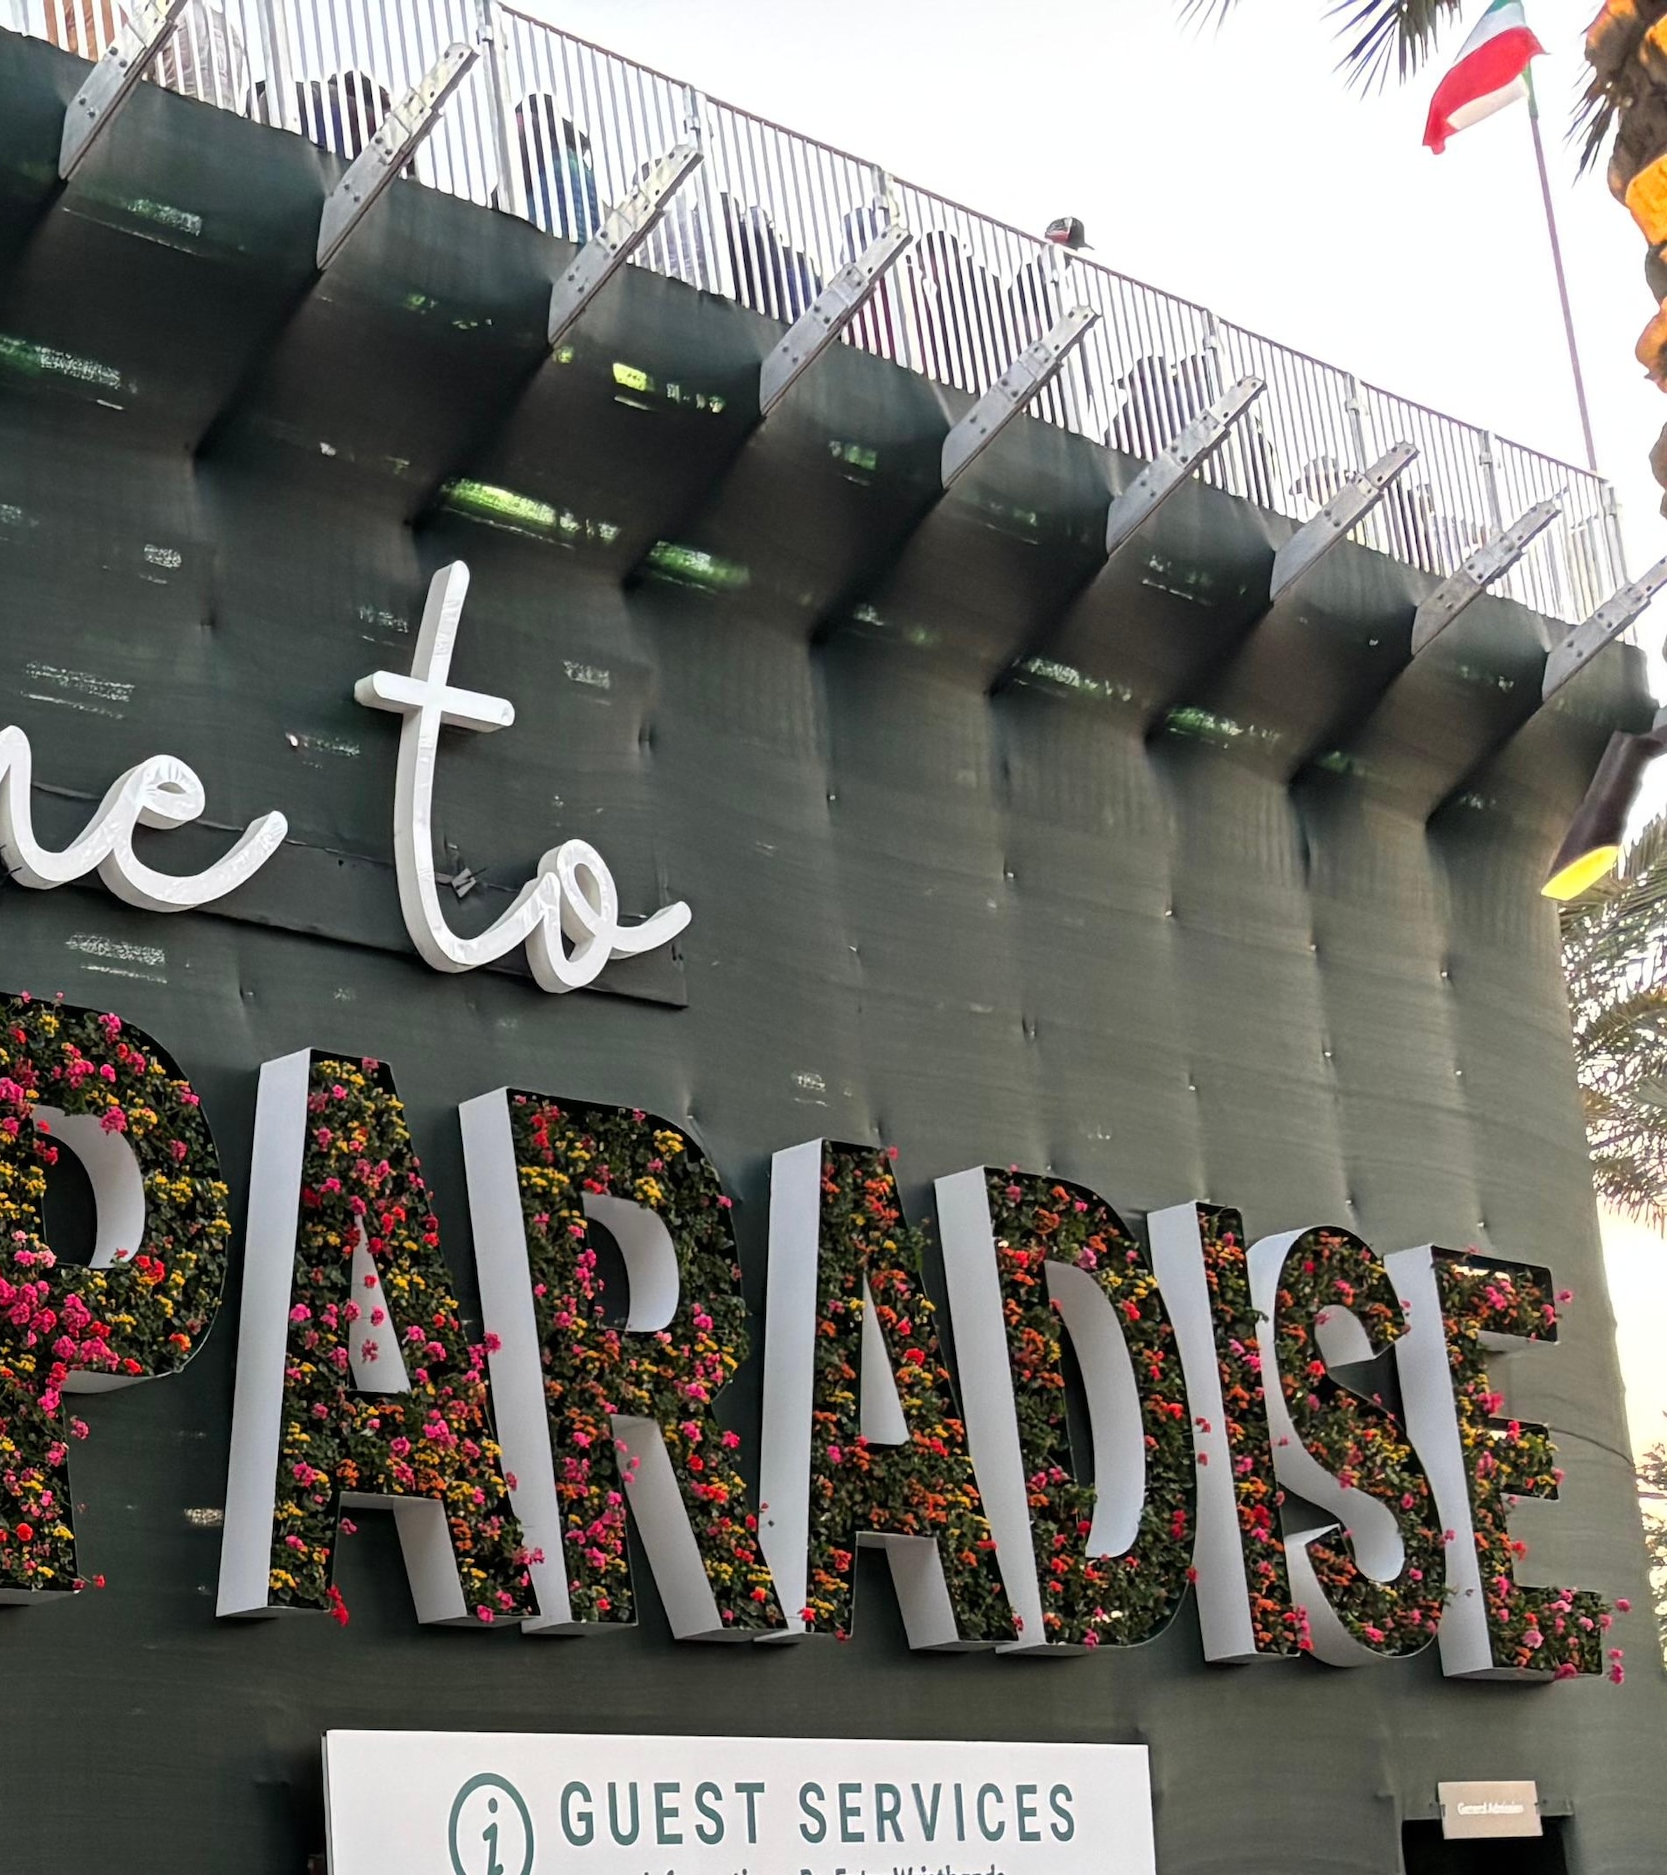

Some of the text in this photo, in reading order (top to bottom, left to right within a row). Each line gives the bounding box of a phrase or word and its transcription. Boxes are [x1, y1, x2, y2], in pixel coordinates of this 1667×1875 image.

[355, 560, 692, 993] to
[561, 1781, 1075, 1846] GUEST SERVICES
